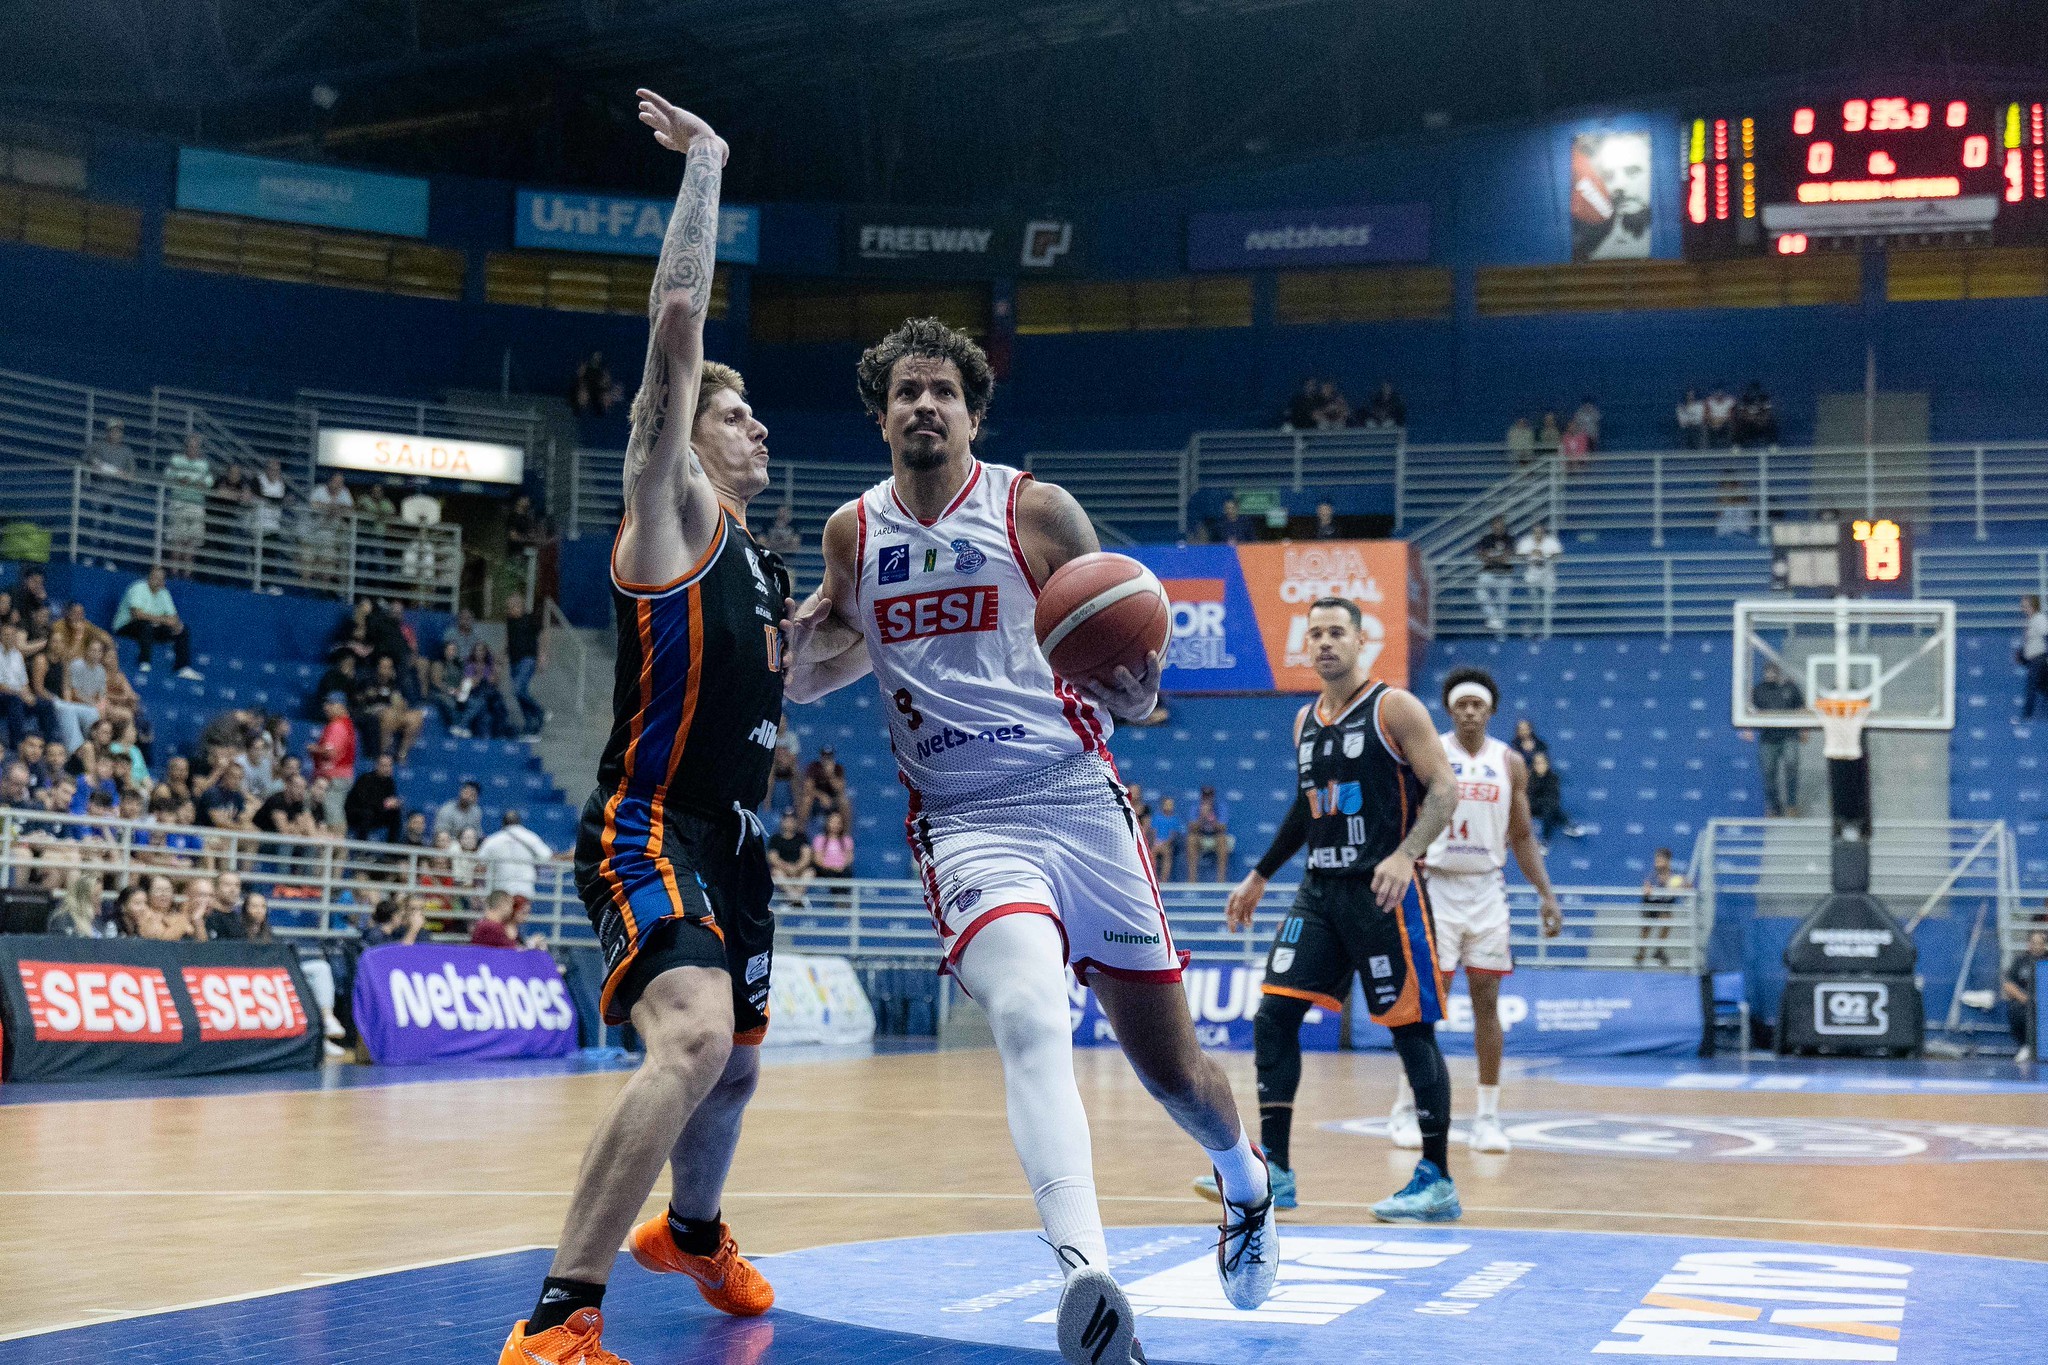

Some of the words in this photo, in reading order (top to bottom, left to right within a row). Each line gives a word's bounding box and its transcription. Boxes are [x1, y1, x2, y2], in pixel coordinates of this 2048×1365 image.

[1807, 141, 1834, 174] 0
[1962, 134, 1989, 169] 0
[860, 225, 993, 252] FREEWAY
[1284, 549, 1369, 579] LOJA
[887, 592, 985, 638] SESI
[893, 688, 923, 730] 9
[1347, 816, 1366, 845] 10
[1104, 930, 1159, 944] Unimed
[1280, 917, 1304, 944] 10
[41, 970, 163, 1033] SESI
[202, 975, 295, 1031] SESI
[1591, 1251, 1914, 1362] CAIXA
